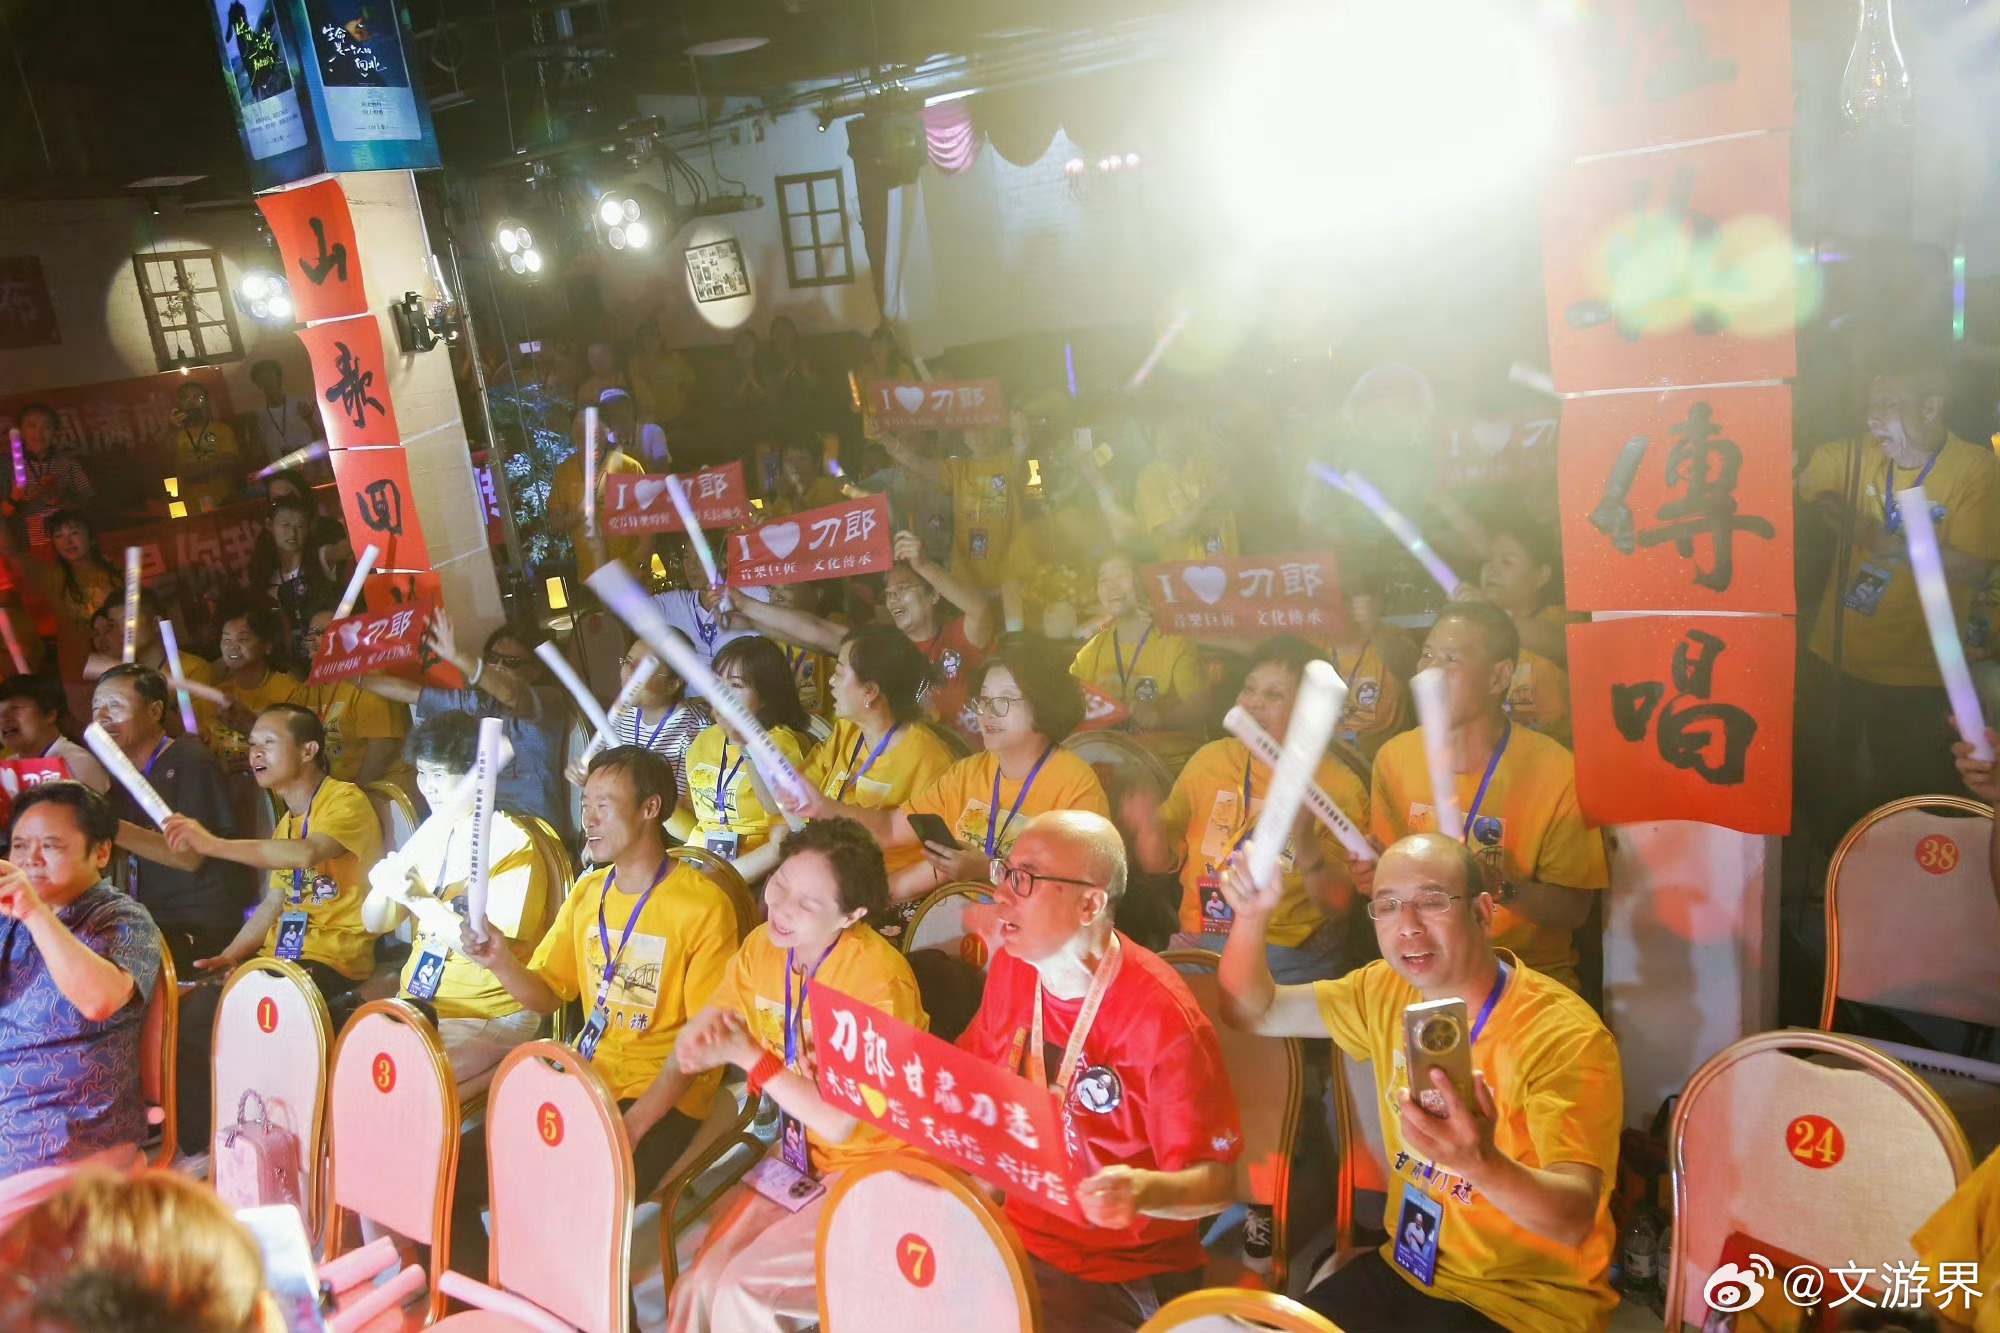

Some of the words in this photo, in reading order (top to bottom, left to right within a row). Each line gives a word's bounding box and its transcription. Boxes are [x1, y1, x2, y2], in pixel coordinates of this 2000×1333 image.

[808, 508, 877, 550] 刀郎
[1239, 562, 1325, 598] 刀郎
[362, 609, 416, 647] 刀郎
[1920, 839, 1957, 872] 38
[262, 1003, 272, 1030] 1
[378, 1061, 391, 1086] 3
[543, 1111, 556, 1140] 5
[1794, 1120, 1837, 1163] 24
[906, 1243, 928, 1280] 7
